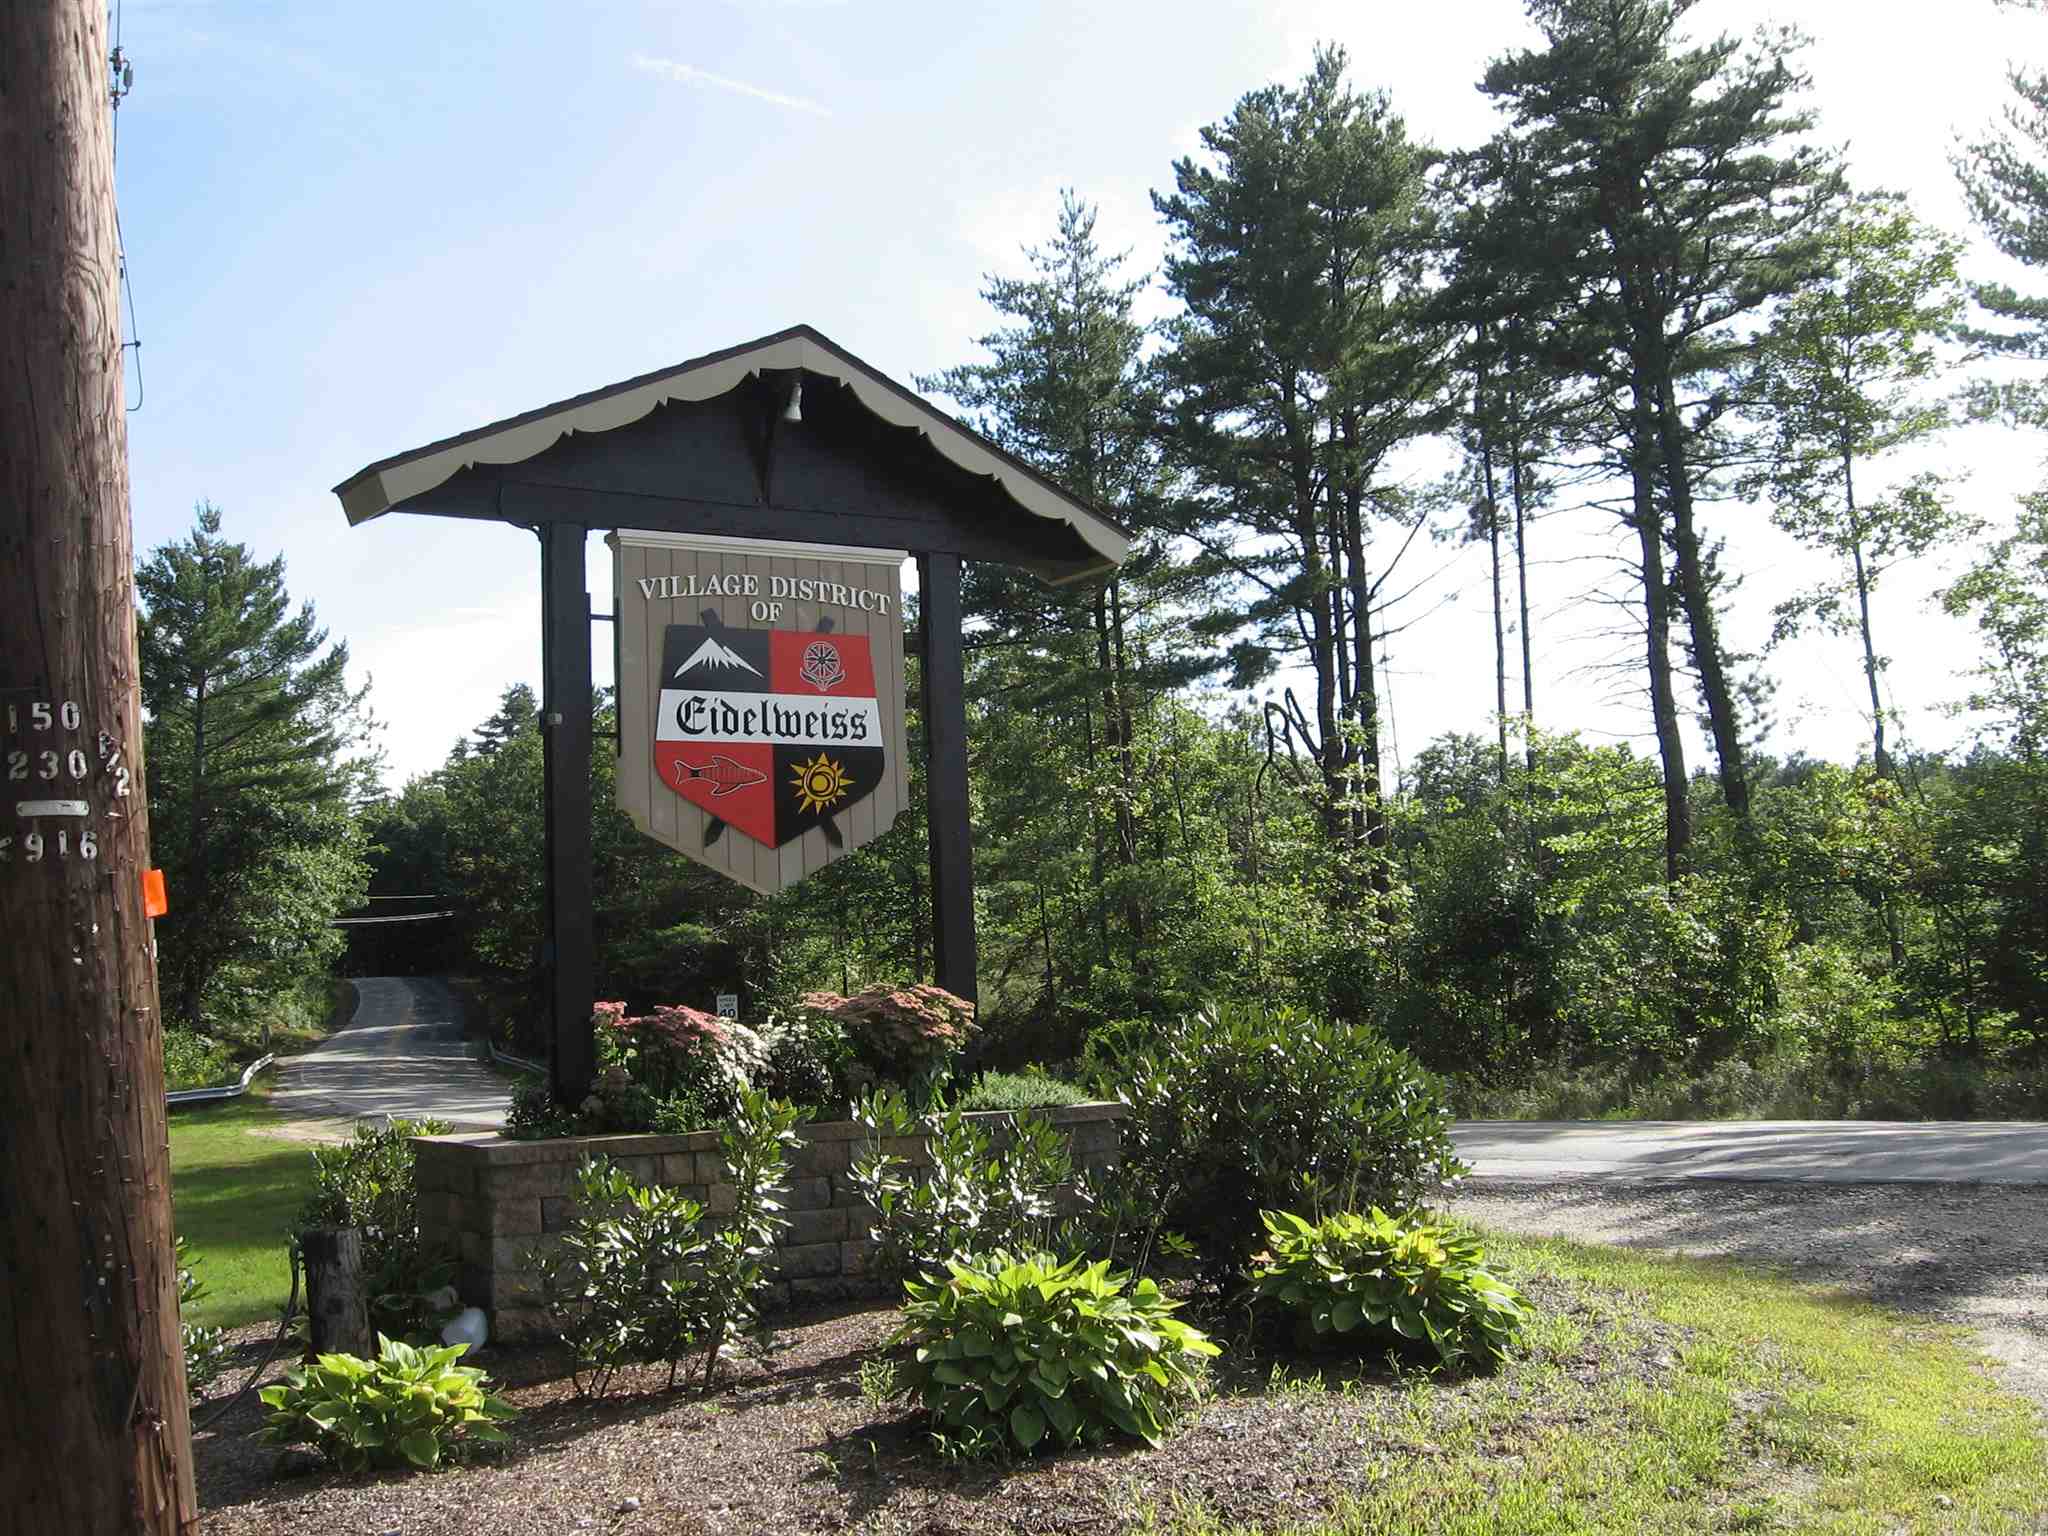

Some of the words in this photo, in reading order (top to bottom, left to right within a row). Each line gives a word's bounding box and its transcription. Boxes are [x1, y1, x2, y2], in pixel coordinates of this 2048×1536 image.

[637, 574, 760, 601] VILLAGE
[770, 575, 892, 616] DISTRICT
[751, 601, 784, 622] OF
[9, 702, 80, 733] 150
